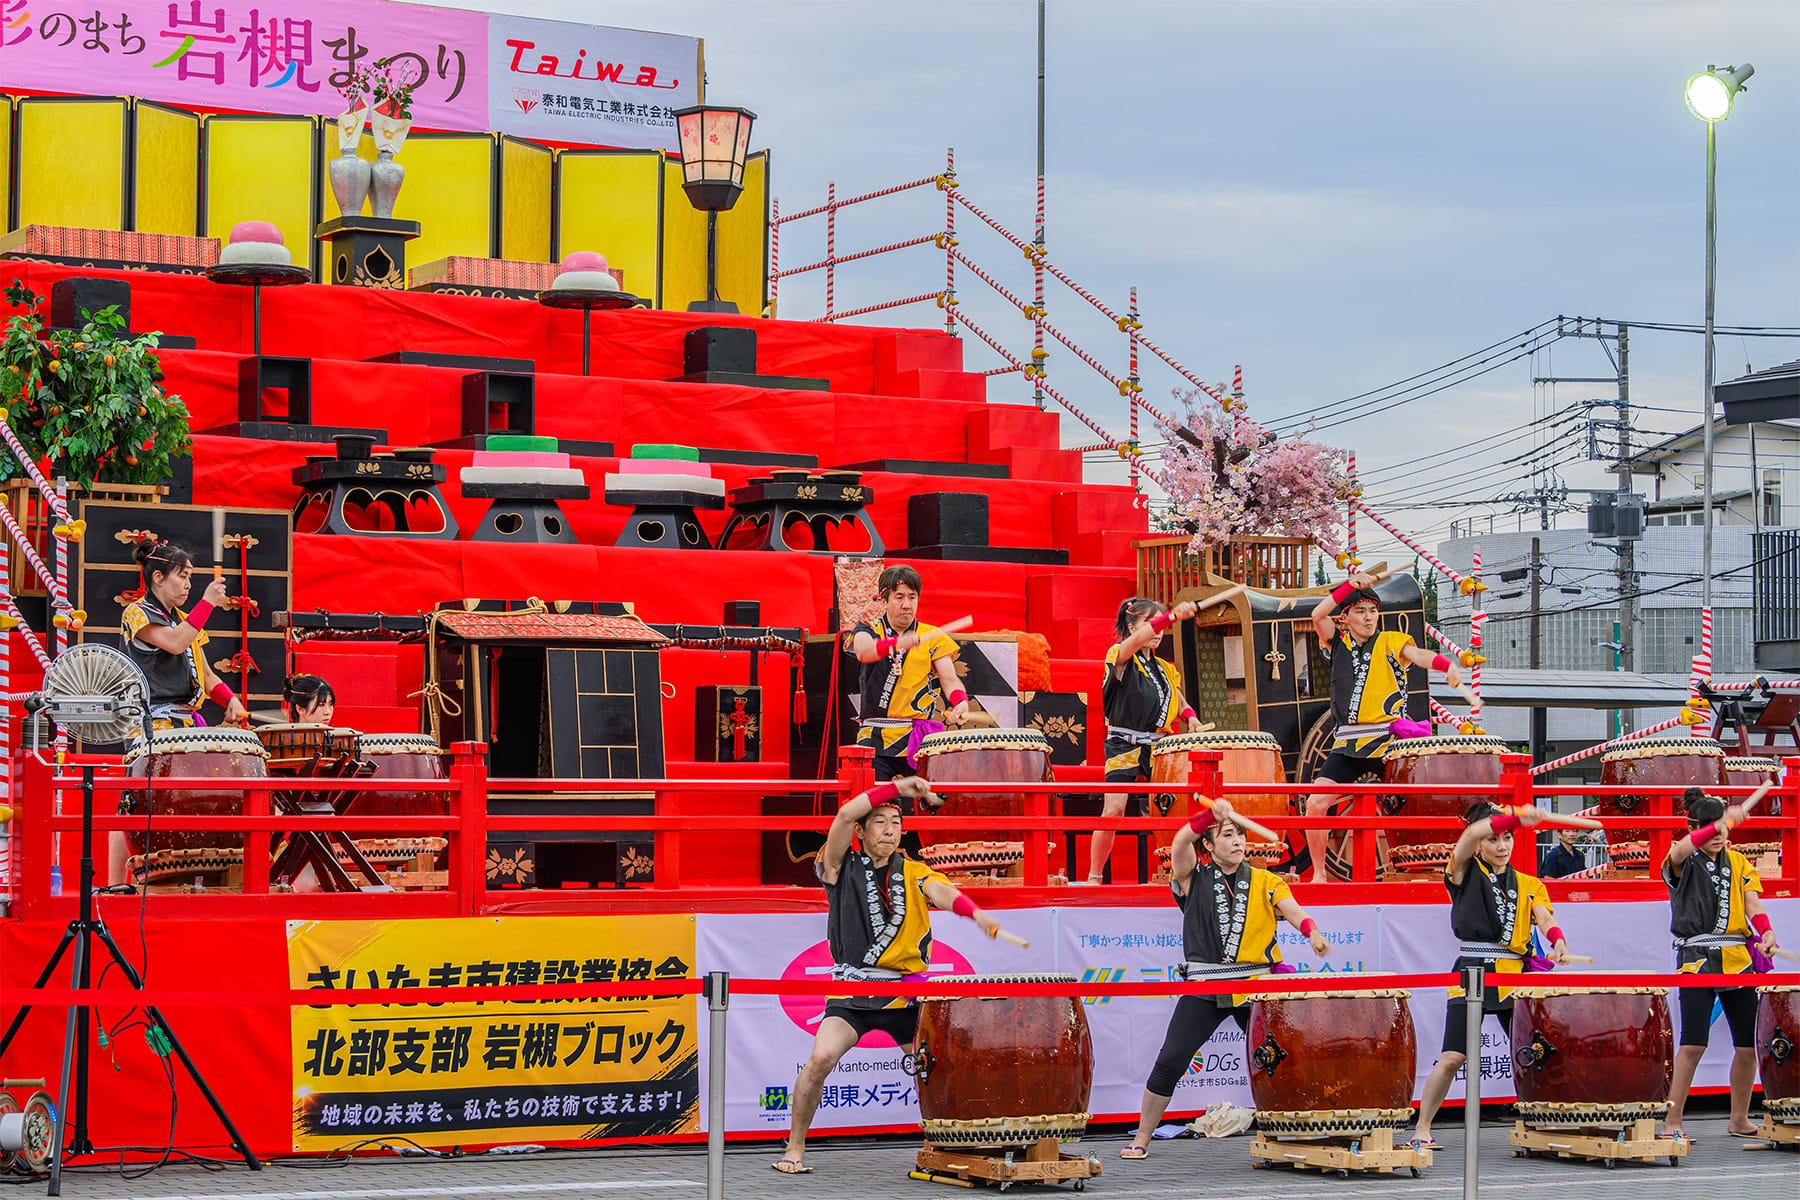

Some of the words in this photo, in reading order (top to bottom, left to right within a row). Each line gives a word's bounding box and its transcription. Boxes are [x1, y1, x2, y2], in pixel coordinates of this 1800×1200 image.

[506, 39, 679, 89] Taiwa
[542, 93, 675, 119] 泰和電気工業株式会社
[544, 108, 566, 116] TAIWA
[568, 110, 602, 120] ELECTRIC
[604, 114, 645, 125] INDUSTRIES
[1275, 931, 1365, 945] すさをけします
[304, 1025, 472, 1077] 北部支部
[482, 1019, 686, 1071] 岩槻ブロック
[1208, 1032, 1246, 1043] AITAMA
[320, 1090, 683, 1126] 地域の未来を、私たちの技術で支えます！
[819, 1082, 918, 1108] 関東メディ
